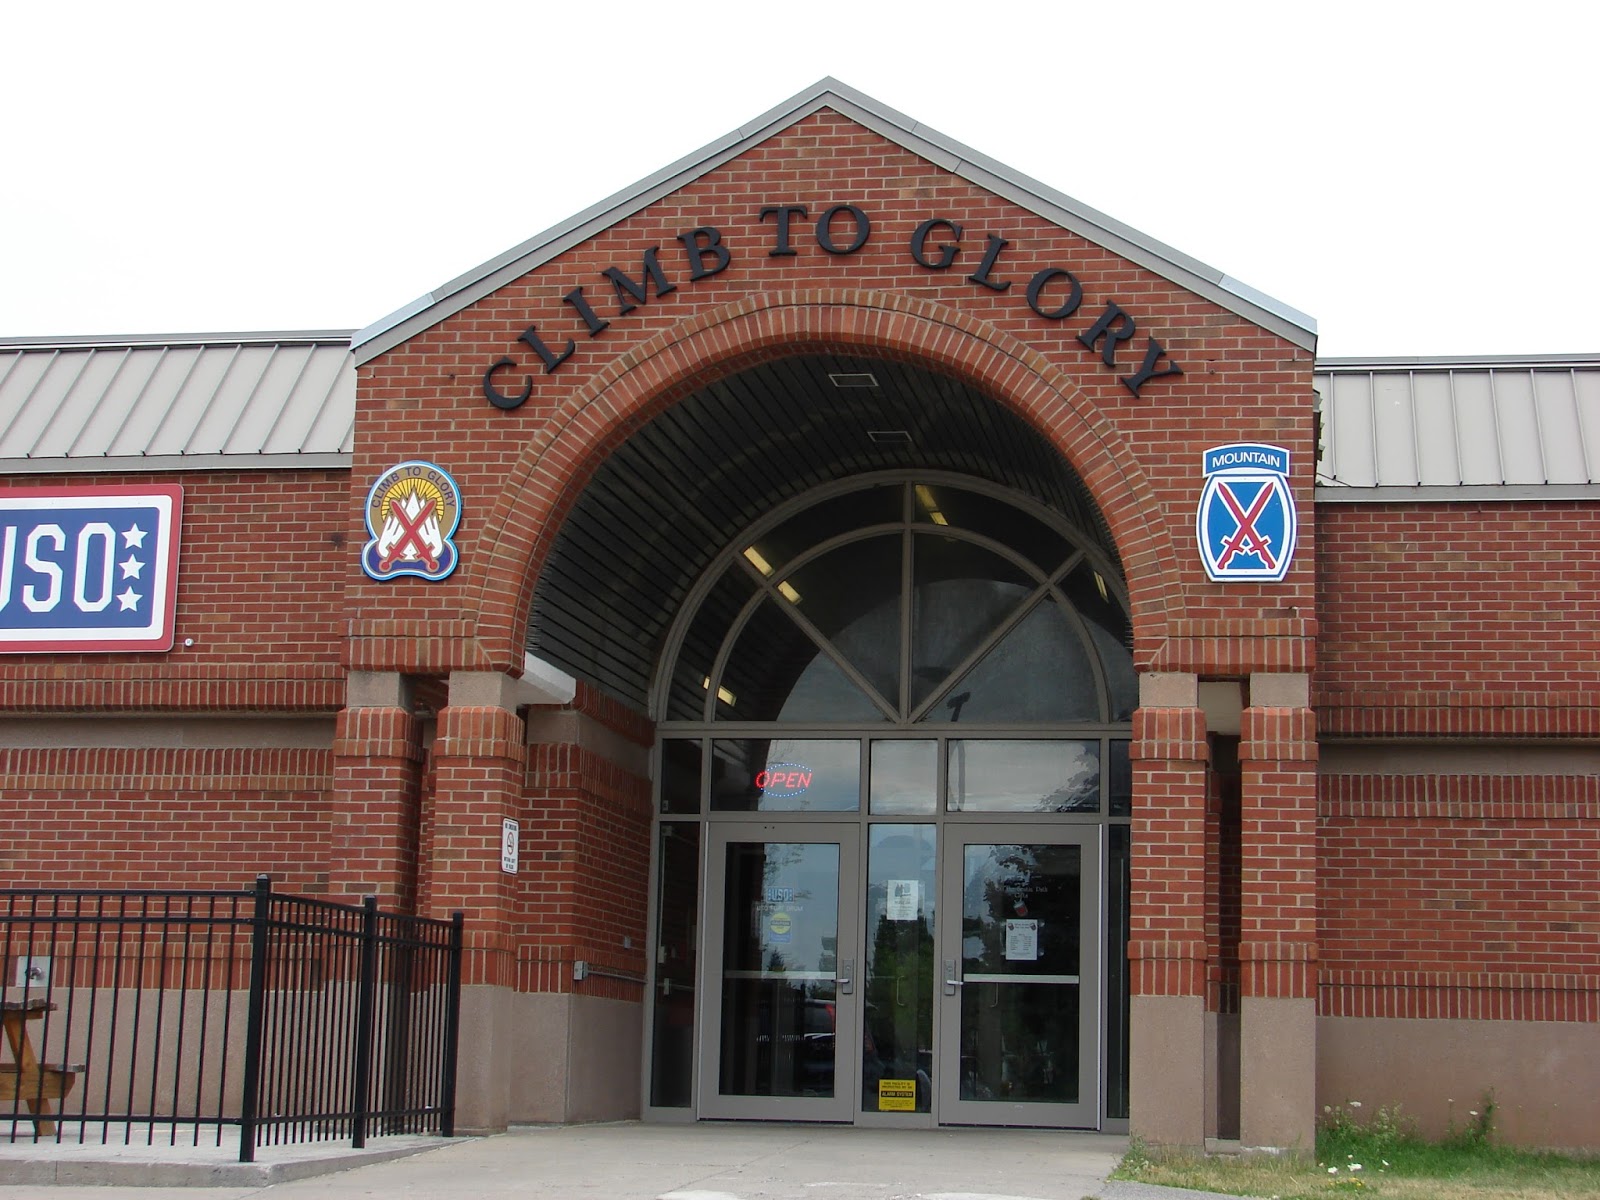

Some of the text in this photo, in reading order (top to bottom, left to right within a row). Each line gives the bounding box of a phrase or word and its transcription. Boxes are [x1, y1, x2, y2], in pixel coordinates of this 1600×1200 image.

[483, 205, 1184, 411] CLIMB TO GLORY
[1212, 452, 1280, 468] MOUNTAIN
[371, 466, 456, 508] CLIMB TO GLORY
[755, 770, 812, 788] OPEN
[771, 888, 789, 901] USO
